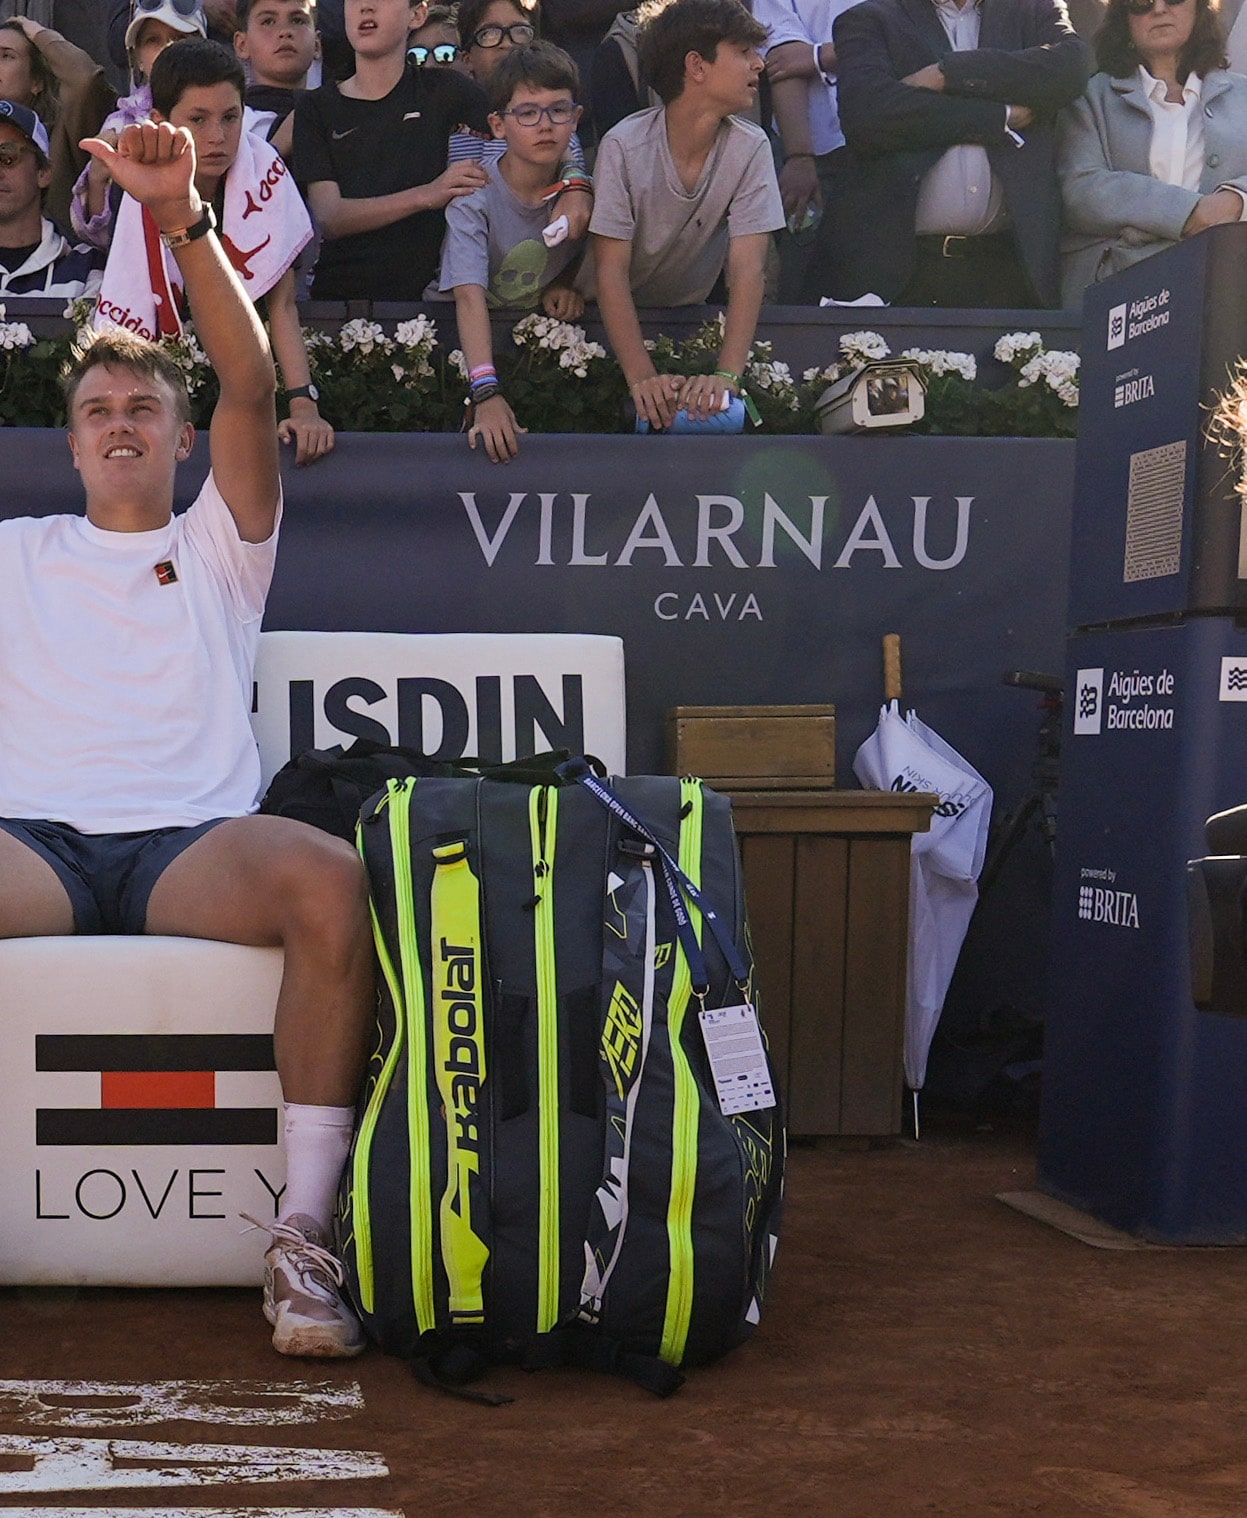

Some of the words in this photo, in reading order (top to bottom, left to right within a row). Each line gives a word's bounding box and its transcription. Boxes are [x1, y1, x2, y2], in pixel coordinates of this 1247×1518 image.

[1158, 288, 1170, 305] de
[98, 293, 156, 342] ccide
[1128, 310, 1170, 340] Barcelona
[1124, 375, 1155, 405] BRITA
[457, 490, 976, 571] VILARNAU
[653, 592, 764, 621] CAVA
[1107, 670, 1154, 704] Aigües
[1155, 669, 1174, 695] de
[288, 673, 585, 765] ISDIN
[1107, 704, 1173, 730] Barcelona
[1080, 866, 1107, 881] powered
[1107, 869, 1116, 883] by
[1094, 887, 1140, 929] BRITA
[35, 1168, 227, 1220] LOVE
